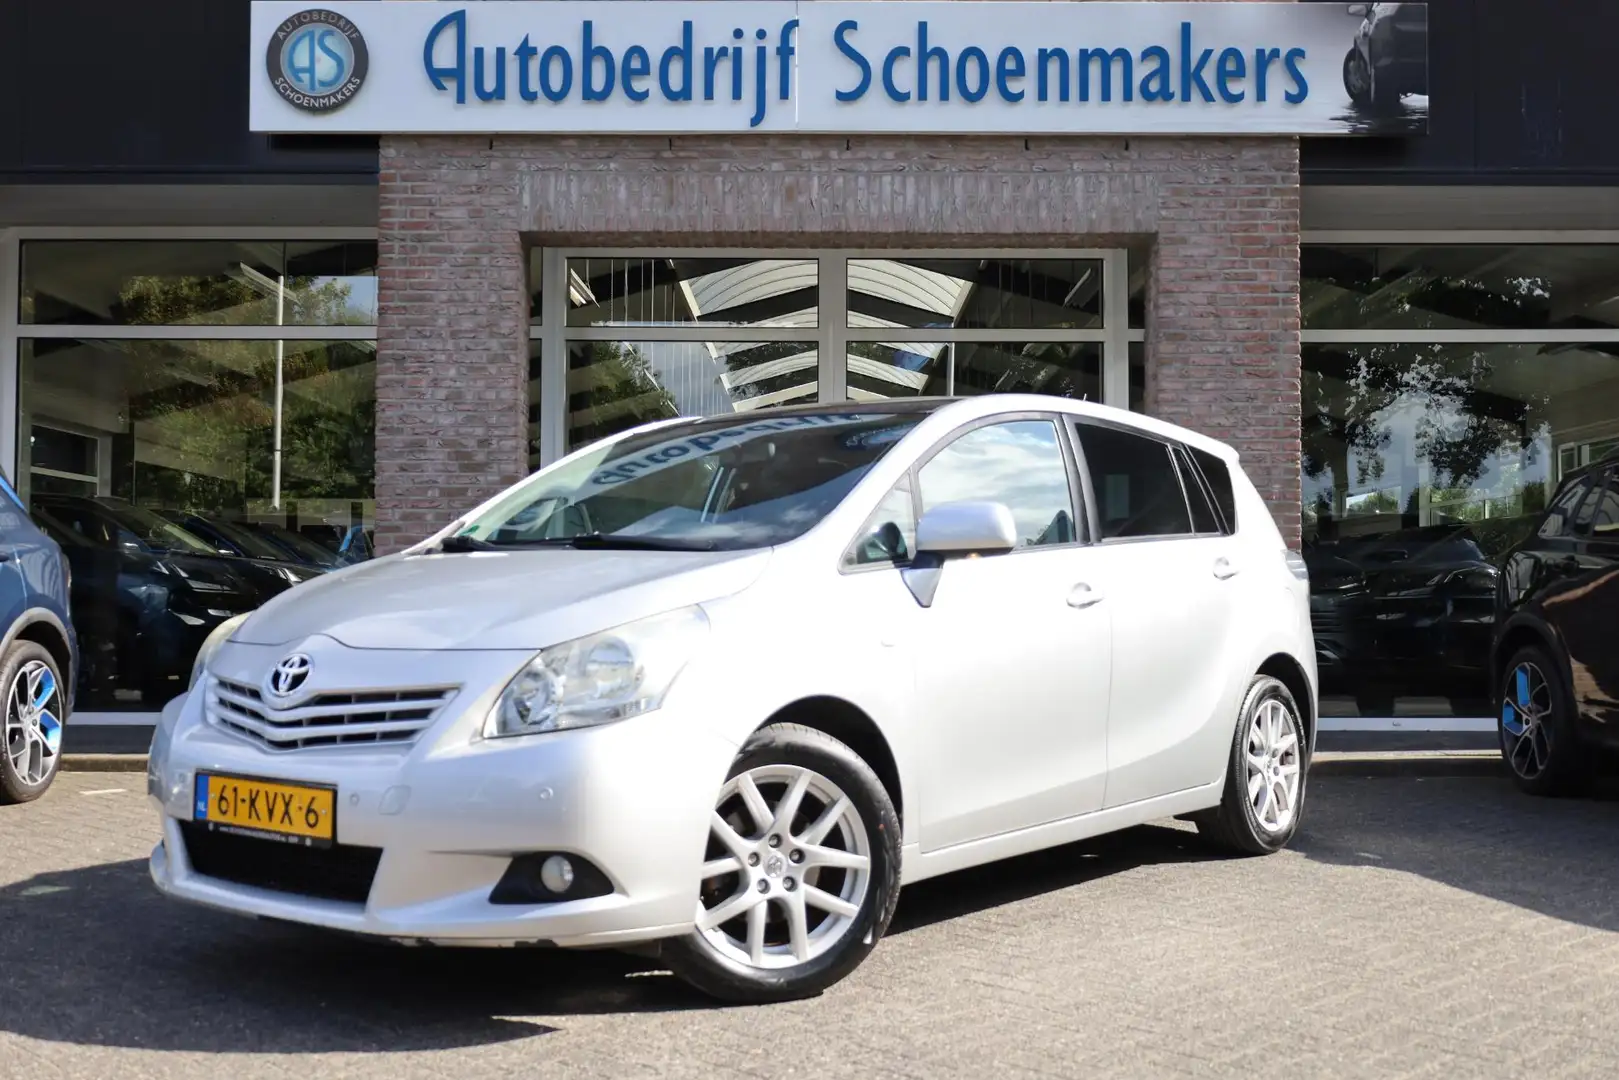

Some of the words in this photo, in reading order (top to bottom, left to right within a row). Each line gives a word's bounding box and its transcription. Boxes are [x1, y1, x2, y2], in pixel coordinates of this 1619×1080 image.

[277, 11, 360, 41] AUTOBEDRIJF
[287, 29, 345, 92] AS
[424, 9, 799, 127] Autobedrijf
[833, 19, 1310, 104] Schoenmakers
[275, 76, 361, 108] SCHOENMAKERS
[217, 784, 319, 829] 61-KVX-6
